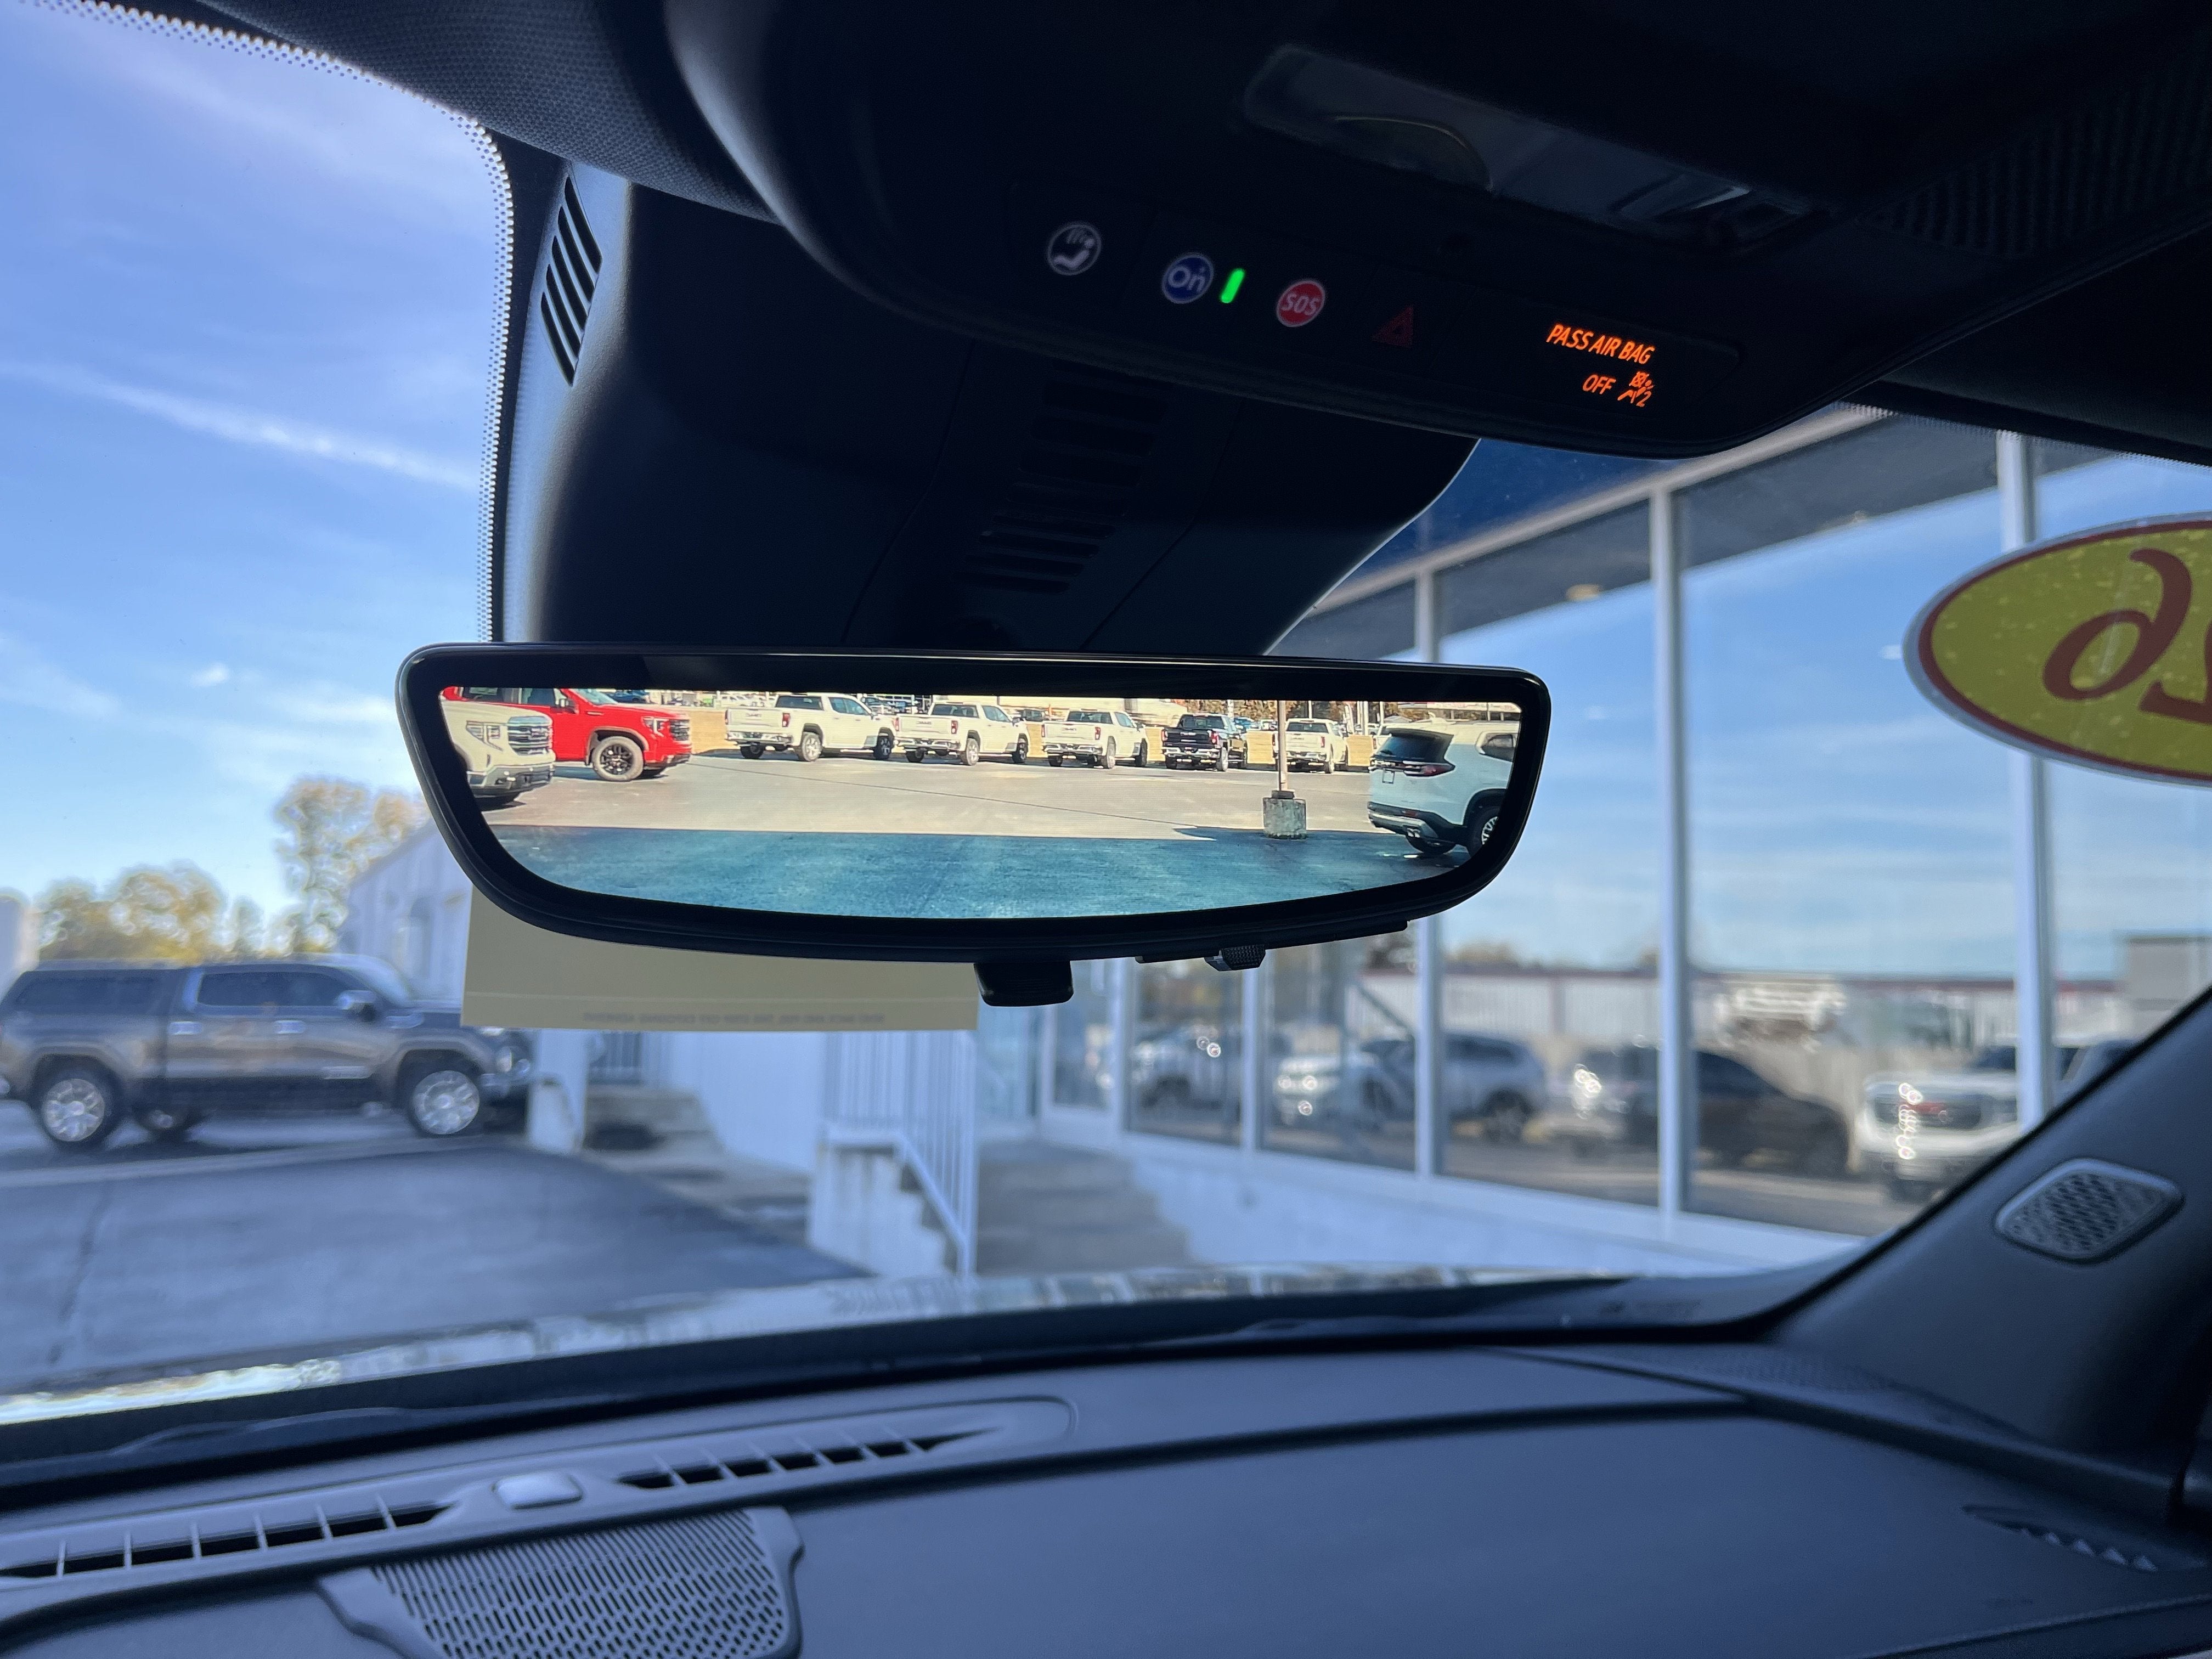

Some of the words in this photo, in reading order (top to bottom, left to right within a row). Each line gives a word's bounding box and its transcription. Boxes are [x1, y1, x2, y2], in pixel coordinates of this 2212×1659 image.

[1167, 266, 1206, 293] On
[1281, 292, 1319, 317] SOS
[1547, 324, 1594, 350] PASS
[1588, 335, 1622, 357] AIR
[1618, 340, 1655, 364] BAG
[1582, 374, 1617, 394] OFF
